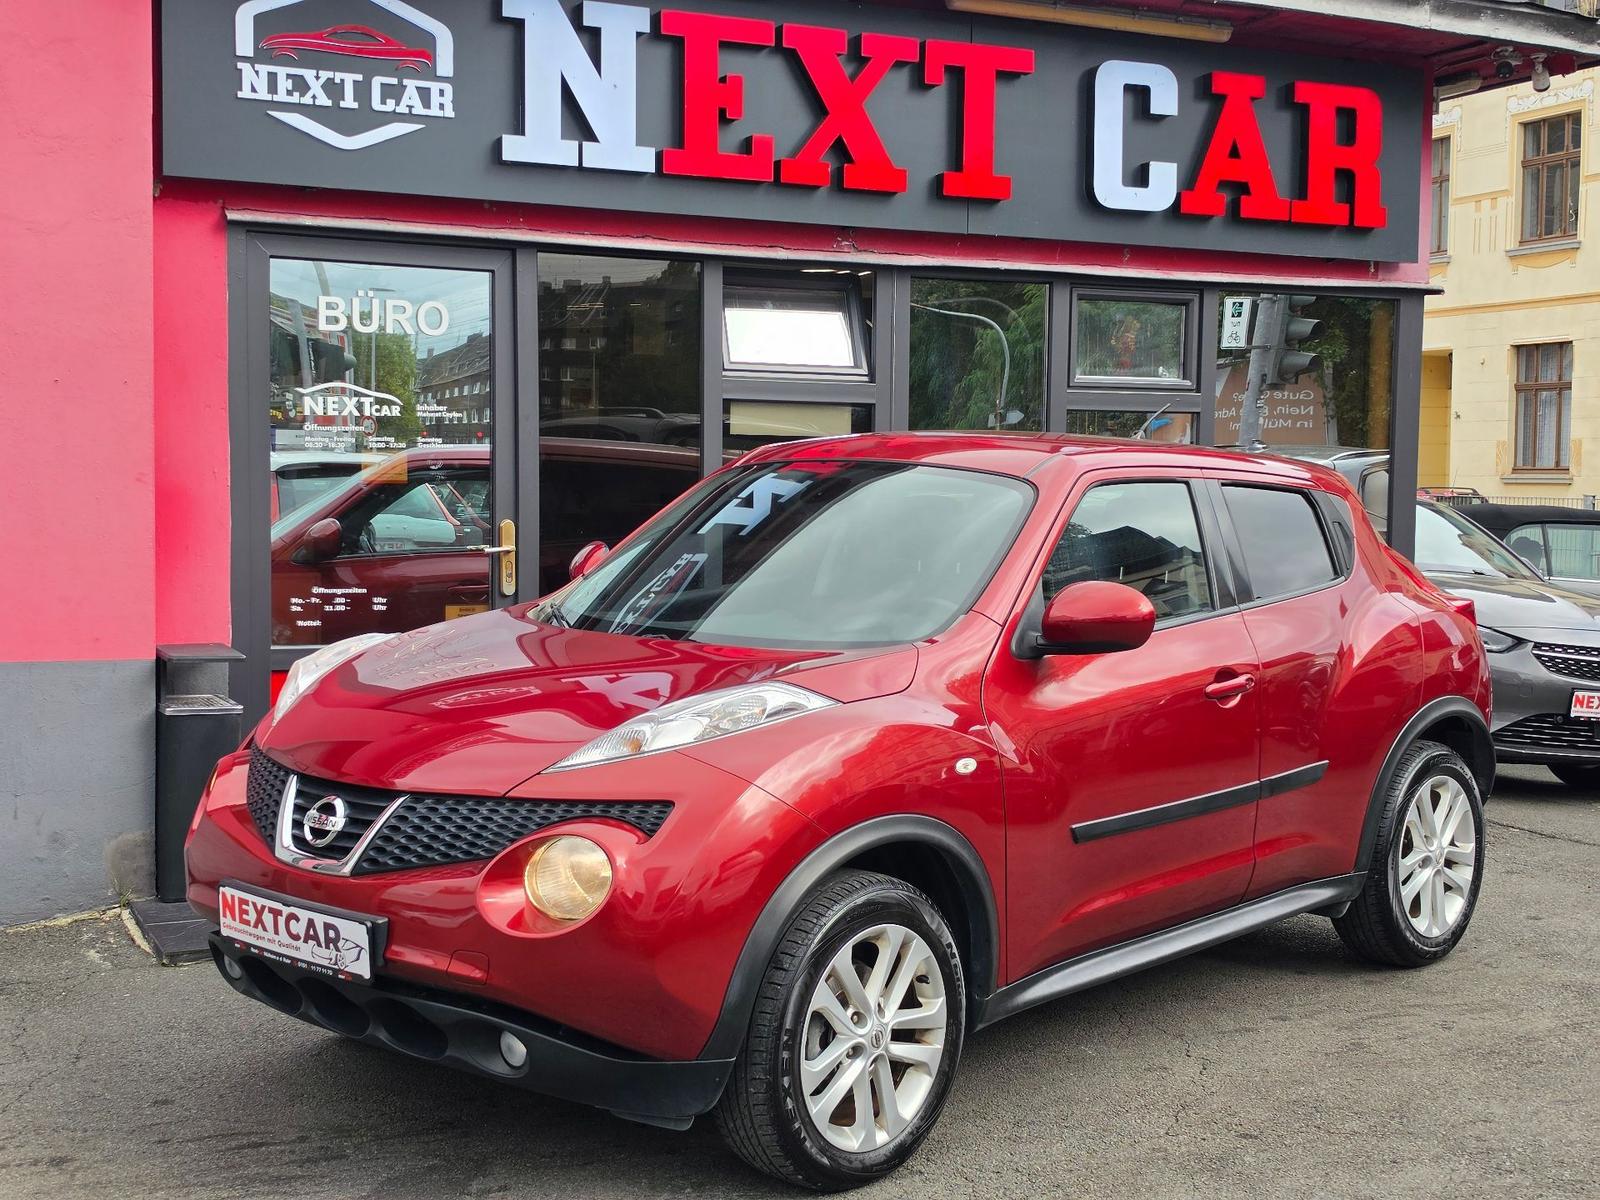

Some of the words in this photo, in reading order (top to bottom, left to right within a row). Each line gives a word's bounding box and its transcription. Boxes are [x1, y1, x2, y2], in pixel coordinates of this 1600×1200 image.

[236, 61, 362, 109] NEXT
[371, 75, 455, 118] CAR
[501, 0, 1035, 200] NEXT
[1094, 59, 1388, 229] CAR
[318, 290, 450, 336] BÜRO
[304, 422, 365, 432] Öffnungszeiten
[312, 586, 367, 595] Öffnungszeiten
[306, 813, 337, 828] NISSAN
[221, 890, 343, 955] NEXTCAR
